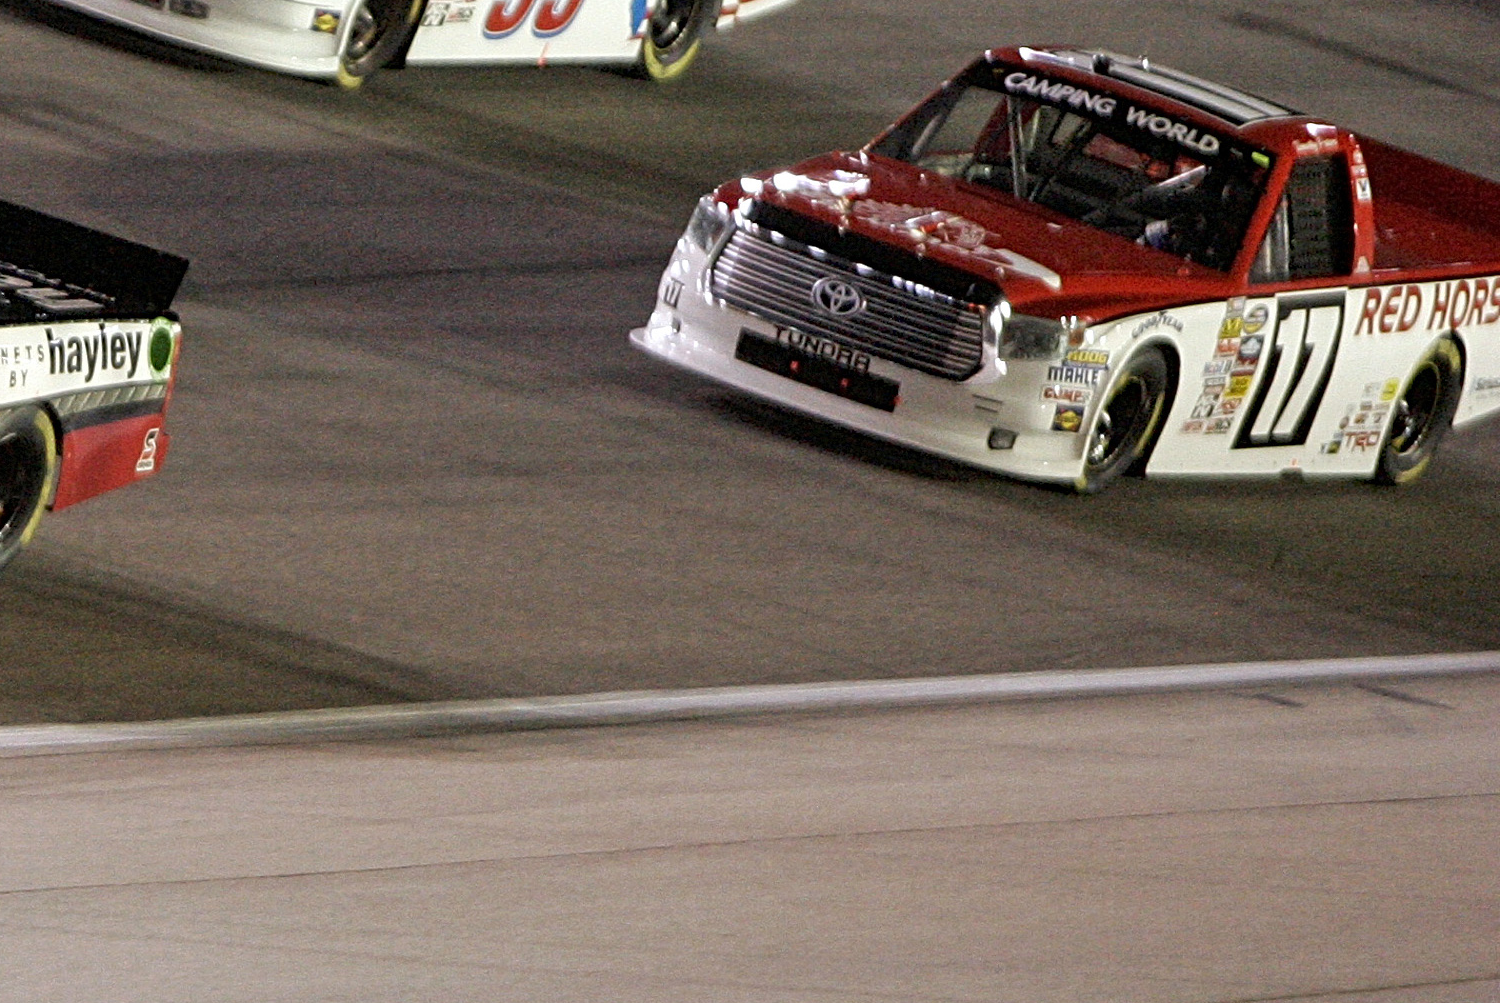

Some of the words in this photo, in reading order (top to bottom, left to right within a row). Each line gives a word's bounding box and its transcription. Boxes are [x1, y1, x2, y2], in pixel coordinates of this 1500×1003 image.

[1004, 72, 1118, 118] CAMPING
[1126, 105, 1221, 157] WORLD
[1354, 283, 1423, 336] RED
[43, 321, 143, 383] hayley
[773, 323, 871, 375] TUNDRA
[8, 368, 30, 388] BY
[1048, 367, 1099, 385] MAHLE
